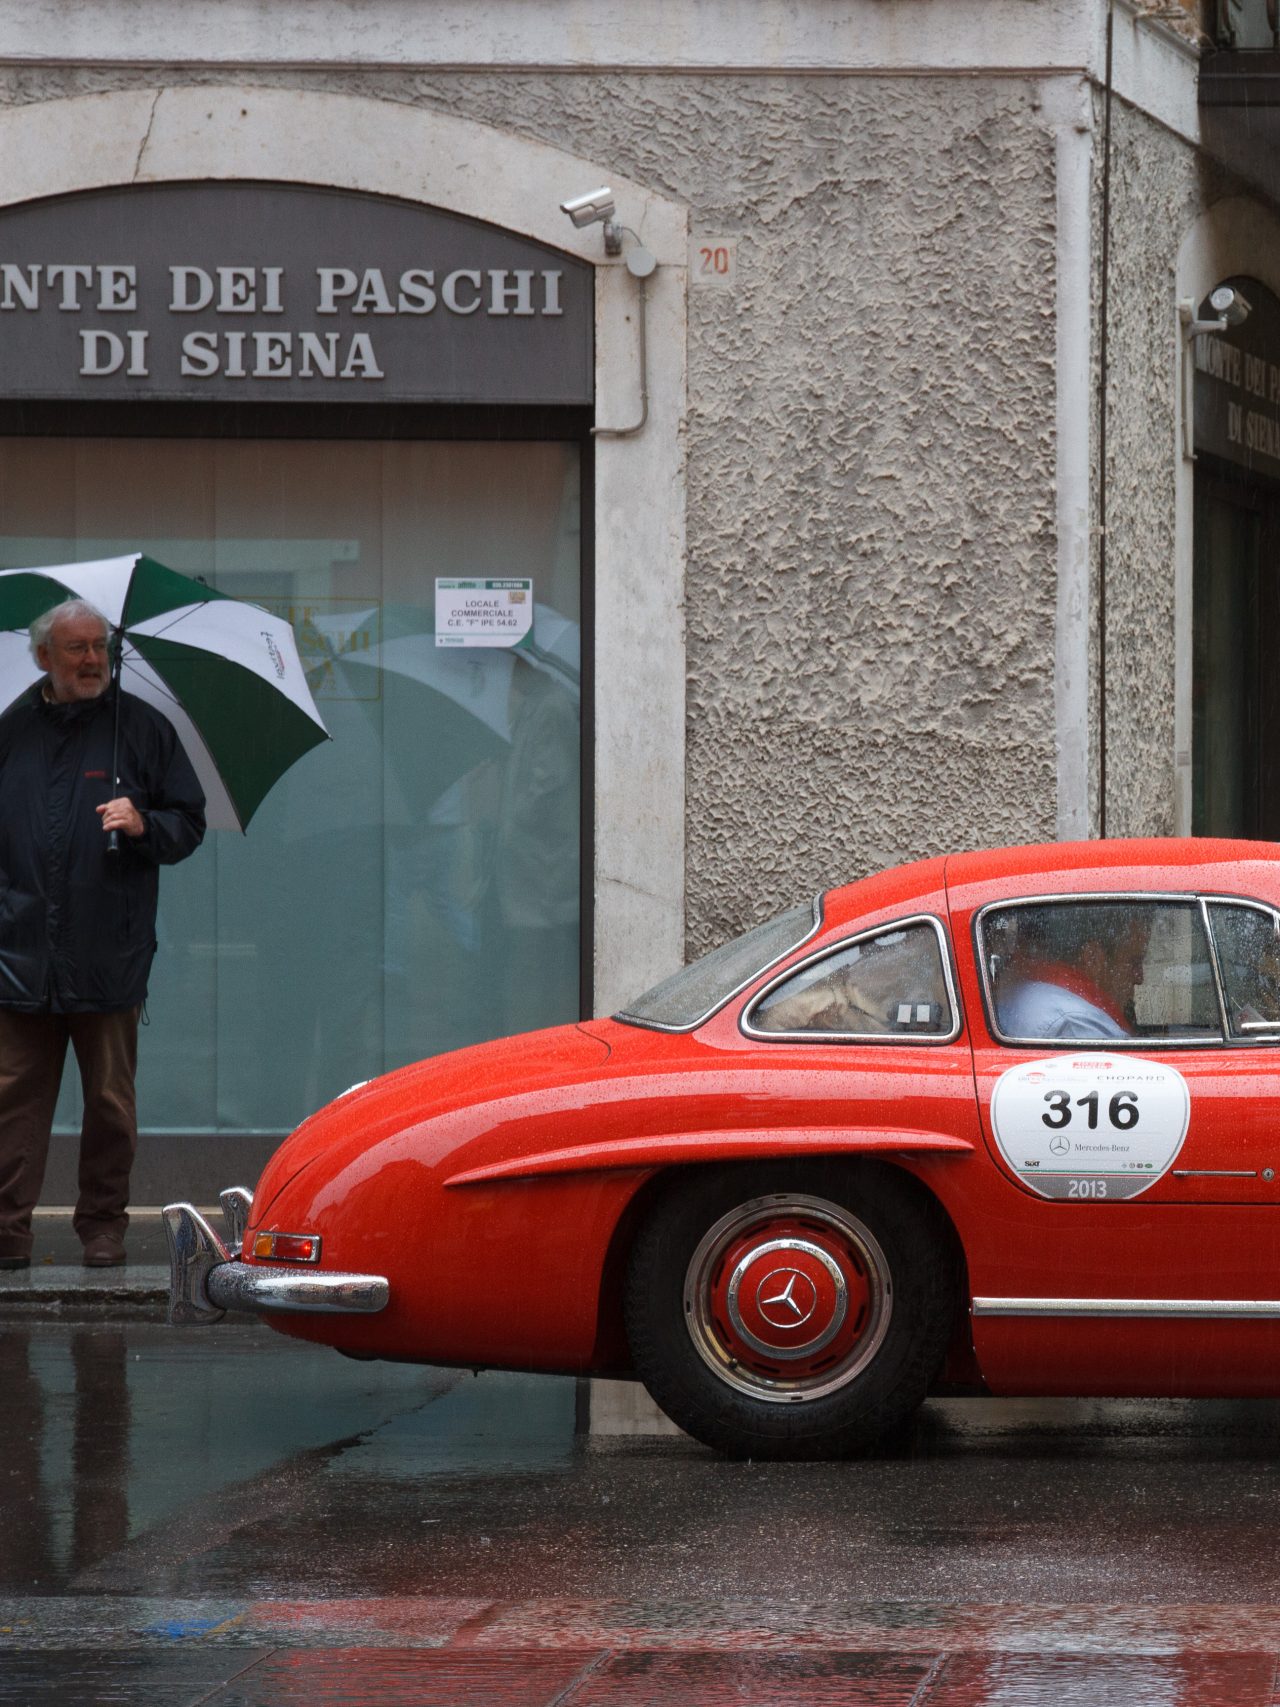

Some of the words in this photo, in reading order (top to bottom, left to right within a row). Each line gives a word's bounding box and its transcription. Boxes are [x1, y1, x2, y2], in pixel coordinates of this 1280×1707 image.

[699, 246, 729, 275] 70
[0, 264, 137, 311] NTE
[168, 266, 284, 313] DEI
[316, 268, 564, 316] PASCHI
[79, 330, 149, 376] DI
[181, 331, 385, 378] SIENA
[1195, 333, 1241, 388] MONTE
[1245, 353, 1266, 398] DEI
[1227, 401, 1242, 445] DI
[1246, 411, 1280, 460] SIENA
[451, 609, 514, 617] COMMERCIALE
[465, 600, 500, 608] LOCALE
[481, 619, 496, 627] IPE
[1041, 1089, 1140, 1130] 316
[1068, 1179, 1108, 1198] 2013
